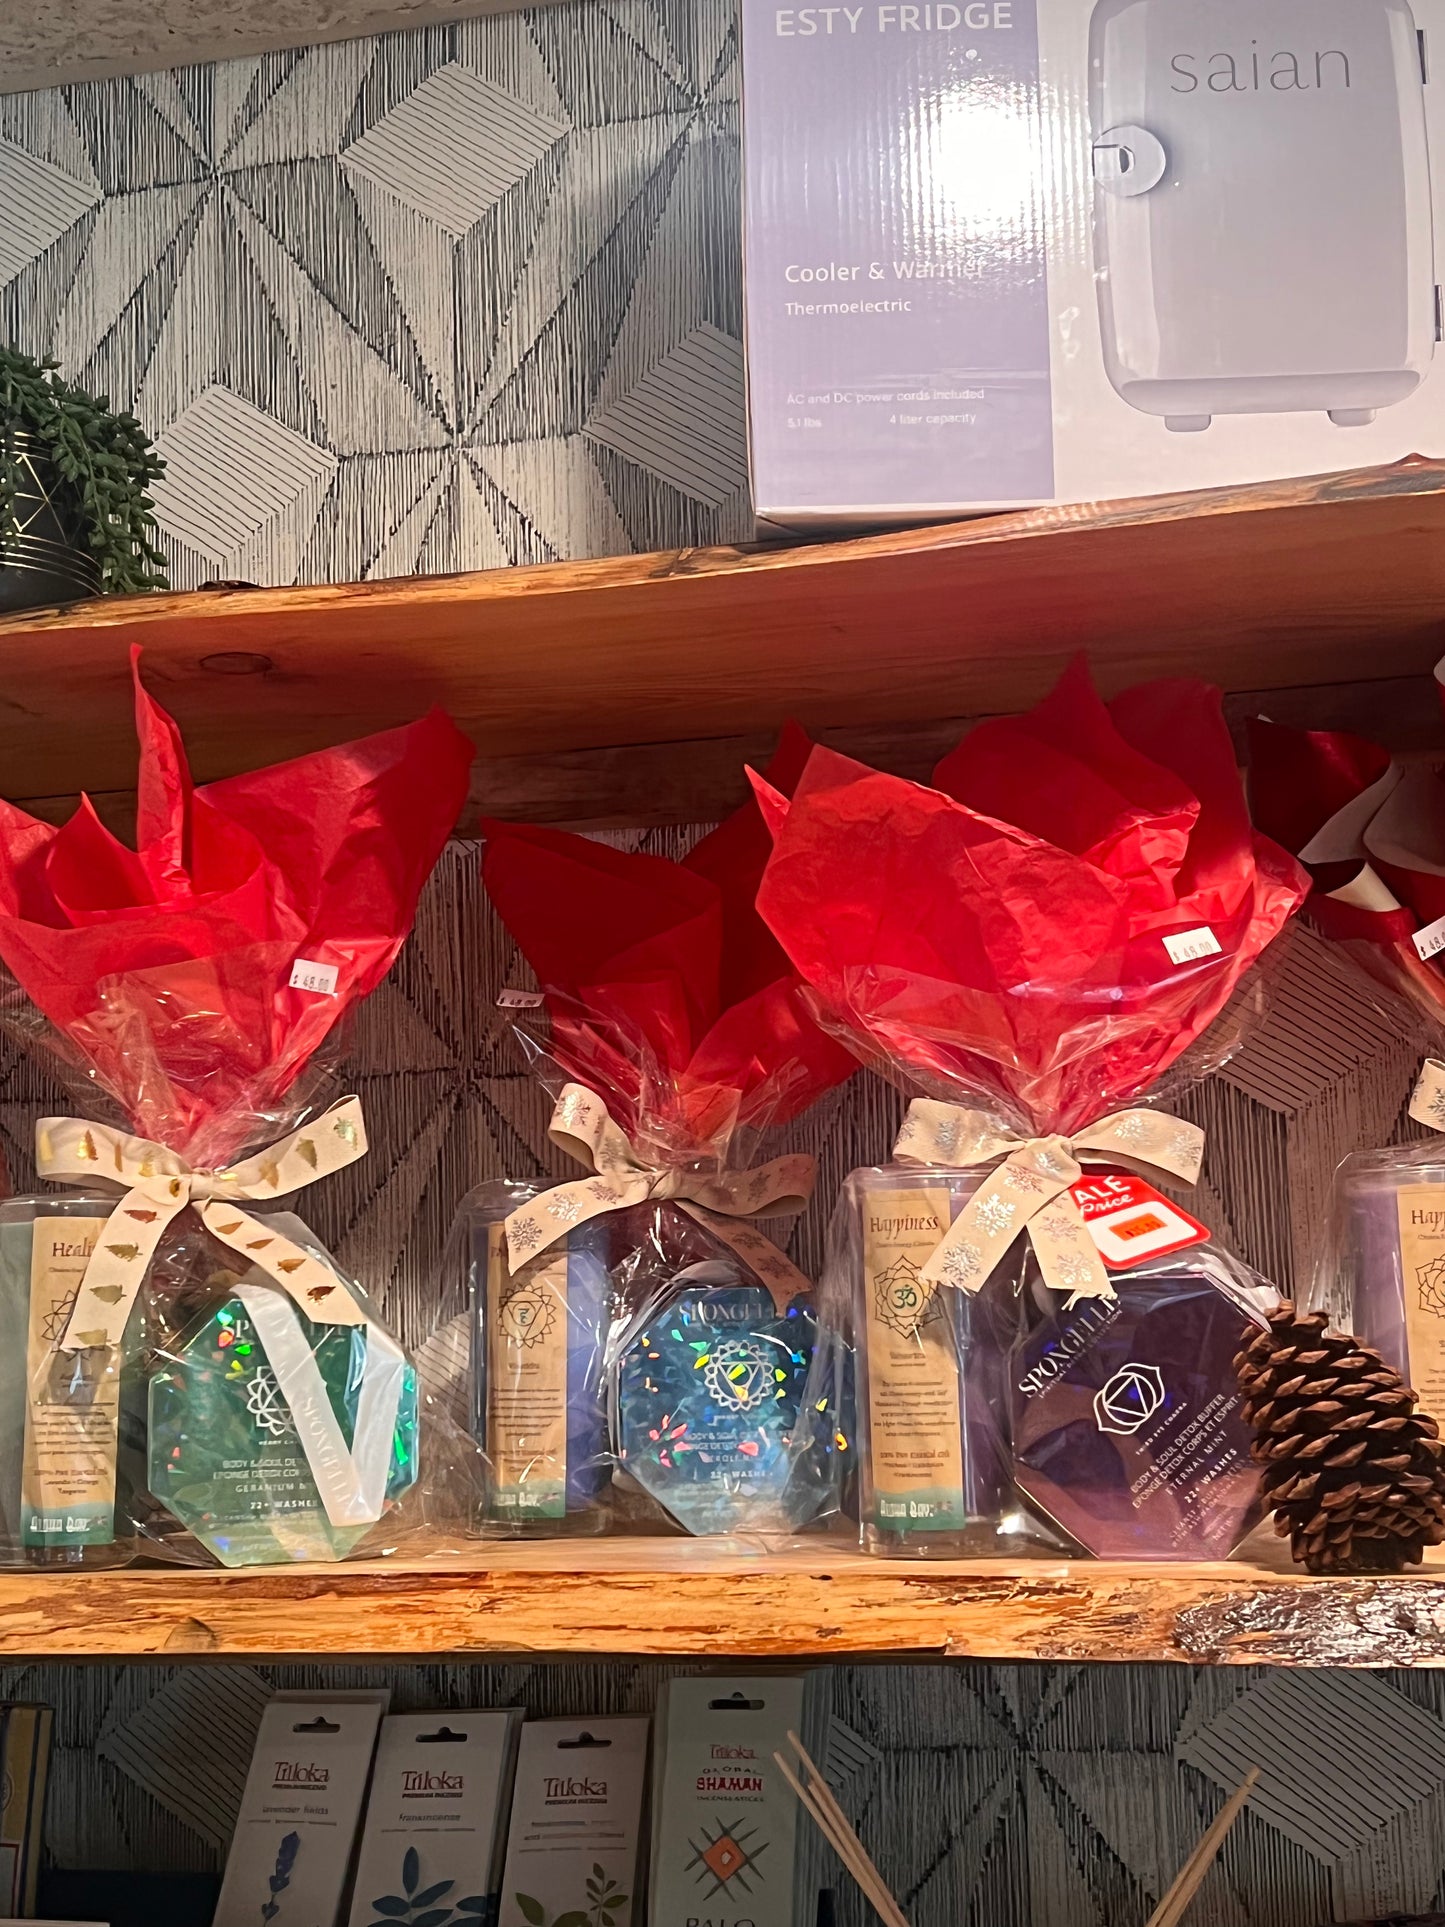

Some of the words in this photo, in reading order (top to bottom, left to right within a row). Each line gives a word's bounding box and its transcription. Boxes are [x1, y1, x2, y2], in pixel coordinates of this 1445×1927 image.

[775, 7, 864, 36] ESTY
[878, 2, 1013, 33] FRIDGE
[1170, 39, 1351, 93] saian
[785, 262, 861, 283] Cooler
[868, 262, 885, 280] &
[893, 260, 984, 280] Warmer
[785, 299, 912, 316] Thermoelectric
[787, 393, 805, 405] AC
[807, 393, 830, 404] and
[856, 392, 893, 406] power
[897, 389, 930, 401] cords
[933, 388, 985, 400] included
[804, 415, 823, 428] lbs
[889, 414, 897, 424] 4
[926, 413, 977, 426] capacity
[1074, 1175, 1132, 1204] ALE
[870, 1214, 939, 1240] Happiness
[1411, 1209, 1445, 1232] Hap
[52, 1237, 94, 1257] Heali
[1156, 1446, 1178, 1467] SOUL
[1174, 1420, 1201, 1447] DETOX
[1197, 1393, 1225, 1423] BUFFER
[1159, 1454, 1185, 1480] DETOX
[1182, 1429, 1208, 1455] CORPS
[1213, 1395, 1239, 1423] ESPRIT
[1165, 1457, 1205, 1496] ETERNAL
[1203, 1429, 1228, 1455] MINT
[1201, 1448, 1238, 1485] WASHES
[696, 1777, 762, 1791] SHAMAN
